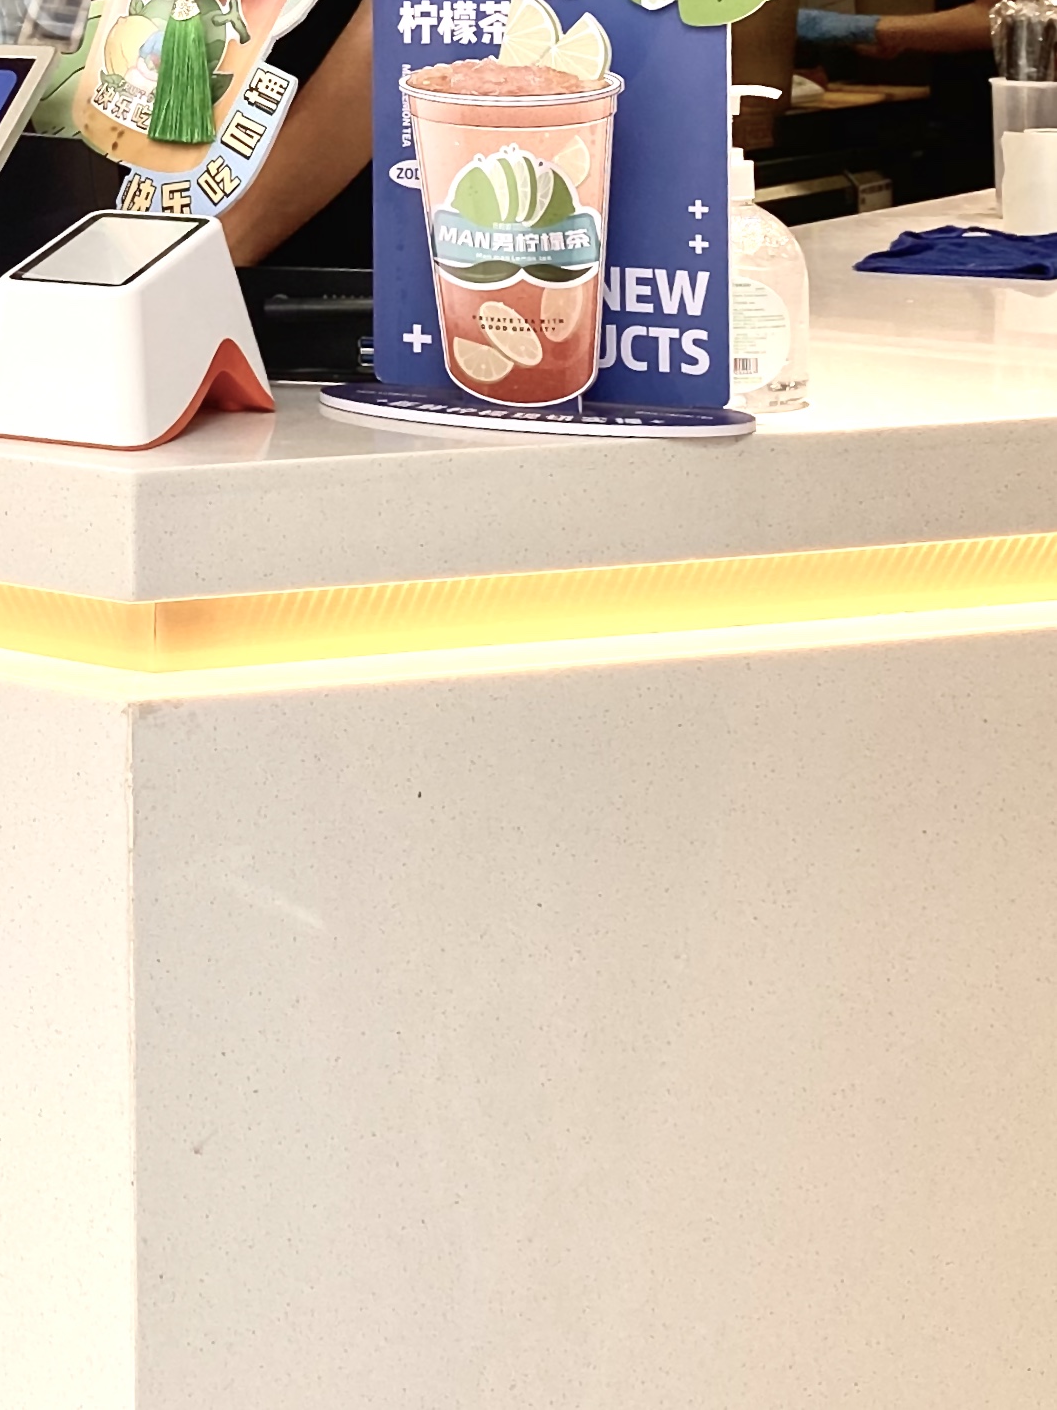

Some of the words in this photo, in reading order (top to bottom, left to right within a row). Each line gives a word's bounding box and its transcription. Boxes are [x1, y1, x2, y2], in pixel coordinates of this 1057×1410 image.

[398, 0, 511, 45] 柠檬茶
[402, 128, 411, 147] TEA
[603, 266, 710, 316] NEW
